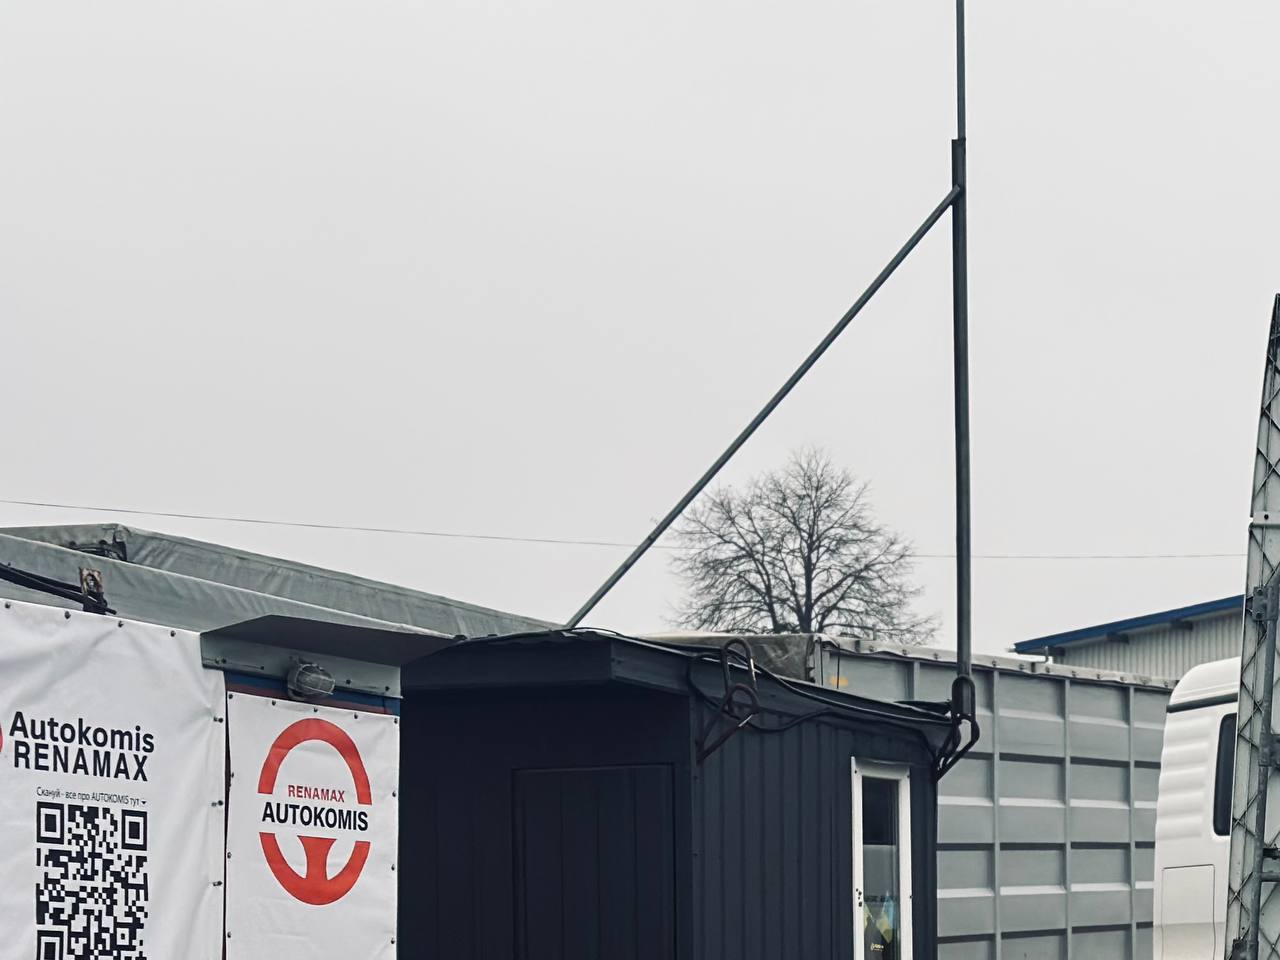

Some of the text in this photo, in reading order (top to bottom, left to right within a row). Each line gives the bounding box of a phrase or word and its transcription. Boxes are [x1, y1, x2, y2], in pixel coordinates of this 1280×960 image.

[9, 711, 155, 753] Autokomis
[14, 740, 148, 782] RENAMAX
[65, 791, 77, 800] все
[77, 792, 91, 803] про
[91, 792, 129, 805] AUTOKOMIS
[287, 784, 345, 803] RENAMAX
[261, 801, 369, 832] AUTOKOMIS
